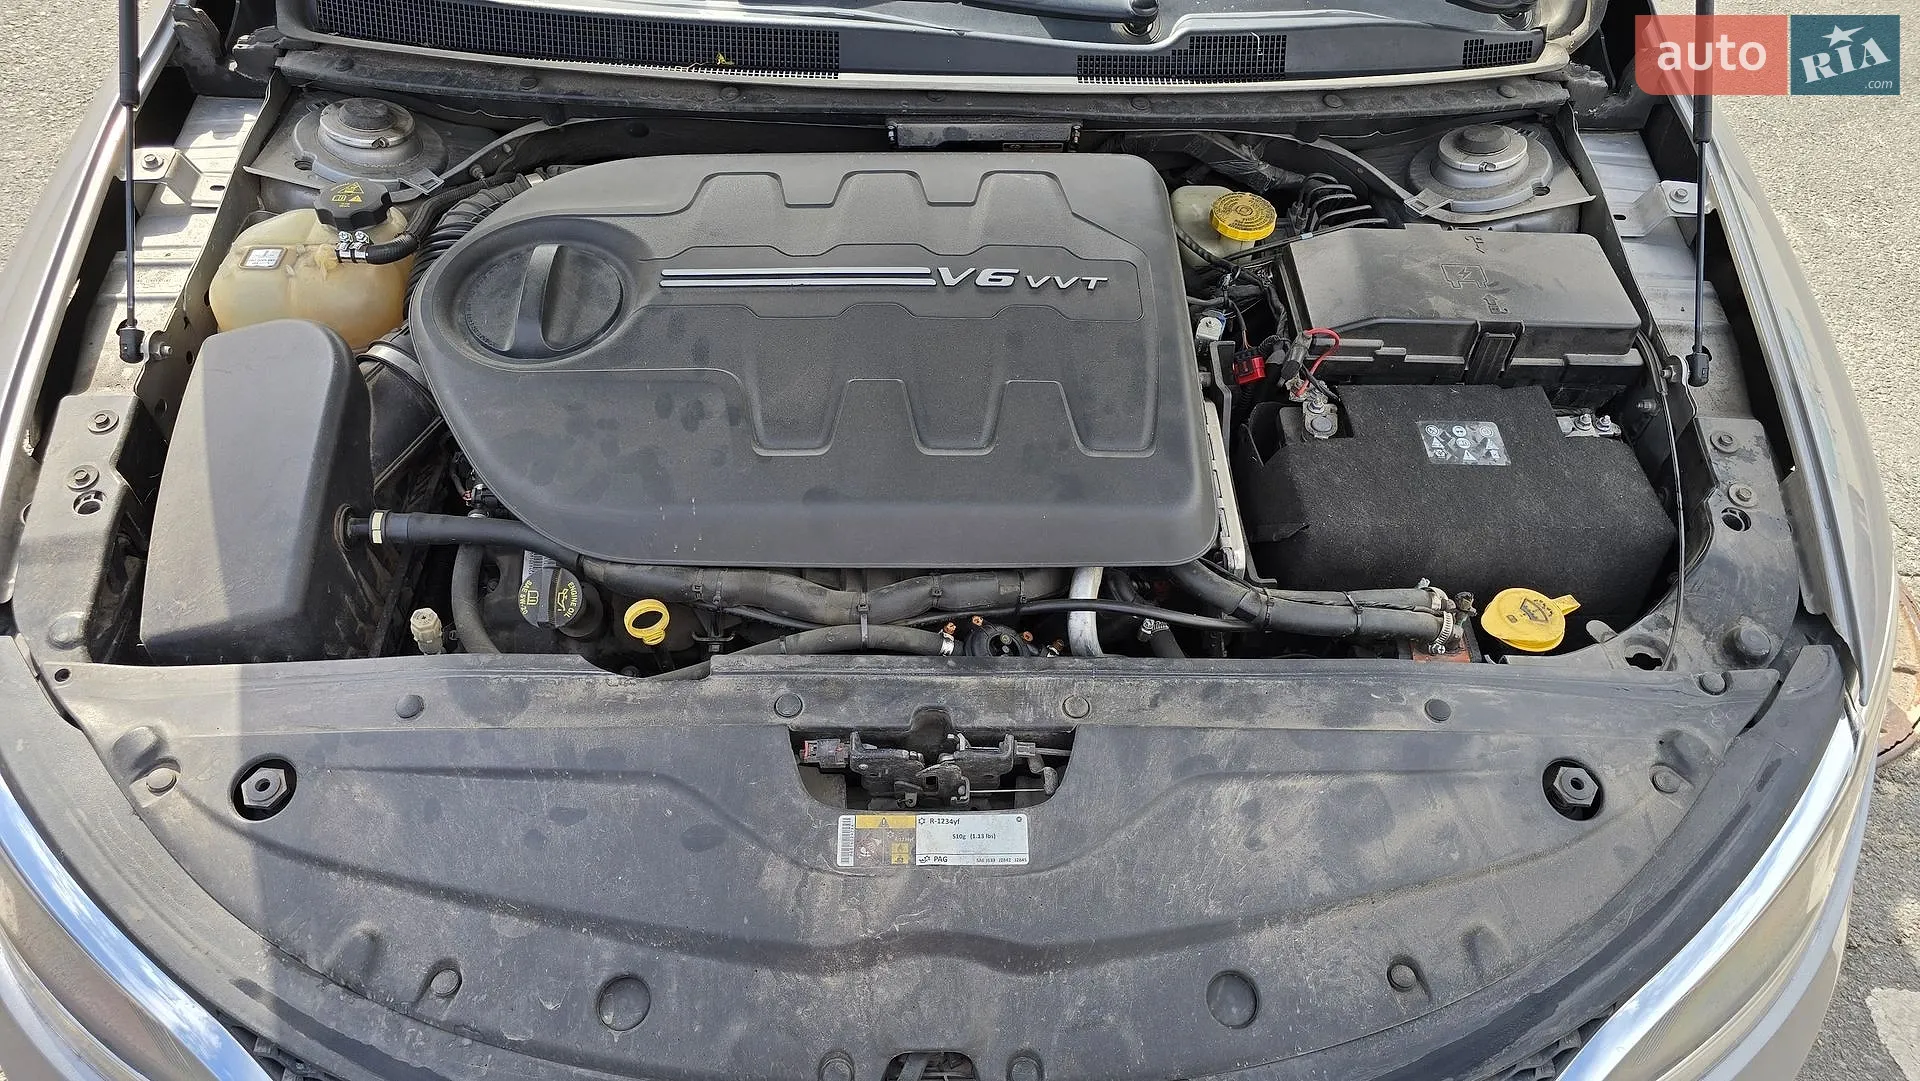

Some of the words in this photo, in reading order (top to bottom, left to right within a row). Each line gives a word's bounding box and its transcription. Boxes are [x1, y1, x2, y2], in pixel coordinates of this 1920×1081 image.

[937, 267, 1020, 287] V6
[1026, 275, 1108, 290] VVT
[521, 579, 533, 594] SAE
[567, 581, 578, 607] ENGINE
[563, 607, 575, 618] OIL
[929, 817, 960, 826] R-1234yf
